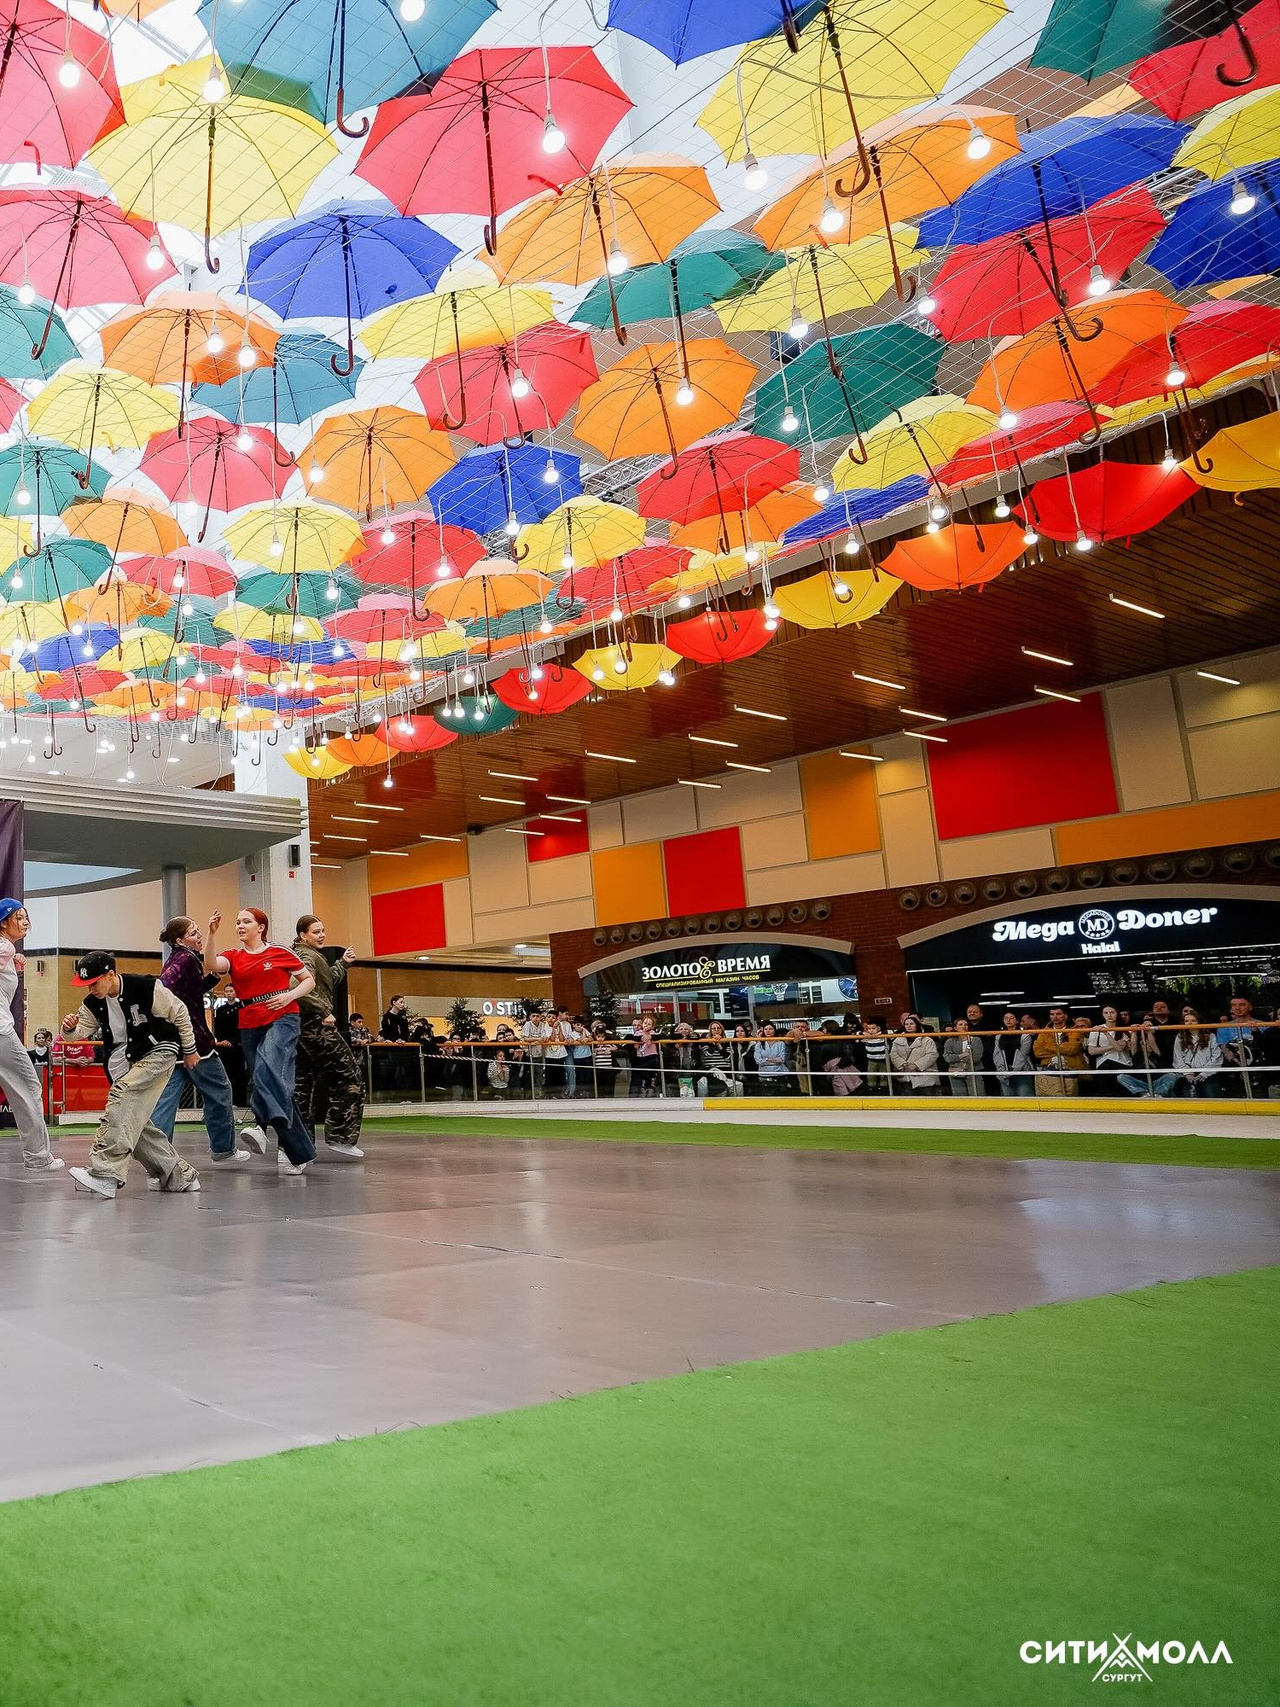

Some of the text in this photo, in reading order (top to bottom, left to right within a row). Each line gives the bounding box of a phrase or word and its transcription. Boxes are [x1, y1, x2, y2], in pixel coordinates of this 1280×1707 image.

[992, 907, 1218, 942] Mega Doner
[1086, 918, 1109, 932] MD
[1081, 941, 1121, 954] Halal
[642, 963, 701, 980] ЗОЛОТО
[717, 955, 771, 973] ВРЕМЯ
